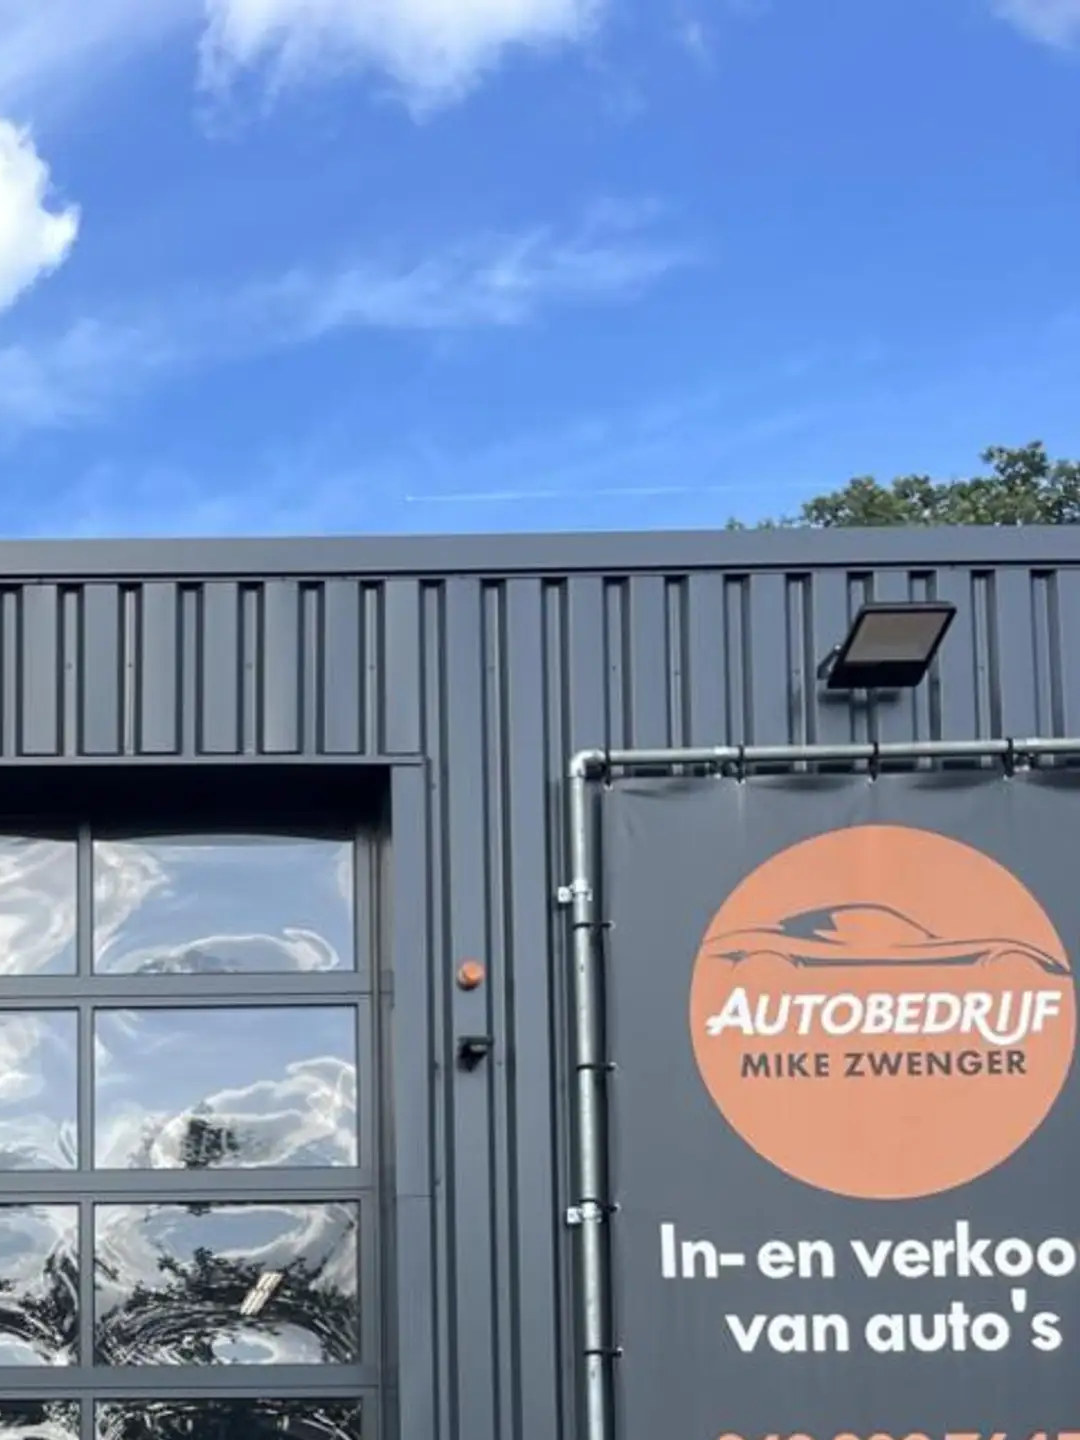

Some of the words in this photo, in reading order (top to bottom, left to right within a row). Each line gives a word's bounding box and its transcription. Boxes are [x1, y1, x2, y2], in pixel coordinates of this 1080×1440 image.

[705, 987, 1062, 1046] AUTOBEDRIJF
[740, 1052, 830, 1078] MIKE
[844, 1050, 1028, 1077] ZWENGER
[660, 1223, 745, 1279] In-
[756, 1239, 835, 1279] en
[849, 1219, 1077, 1279] verkoo
[725, 1313, 850, 1353] van
[864, 1287, 1064, 1353] auto's
